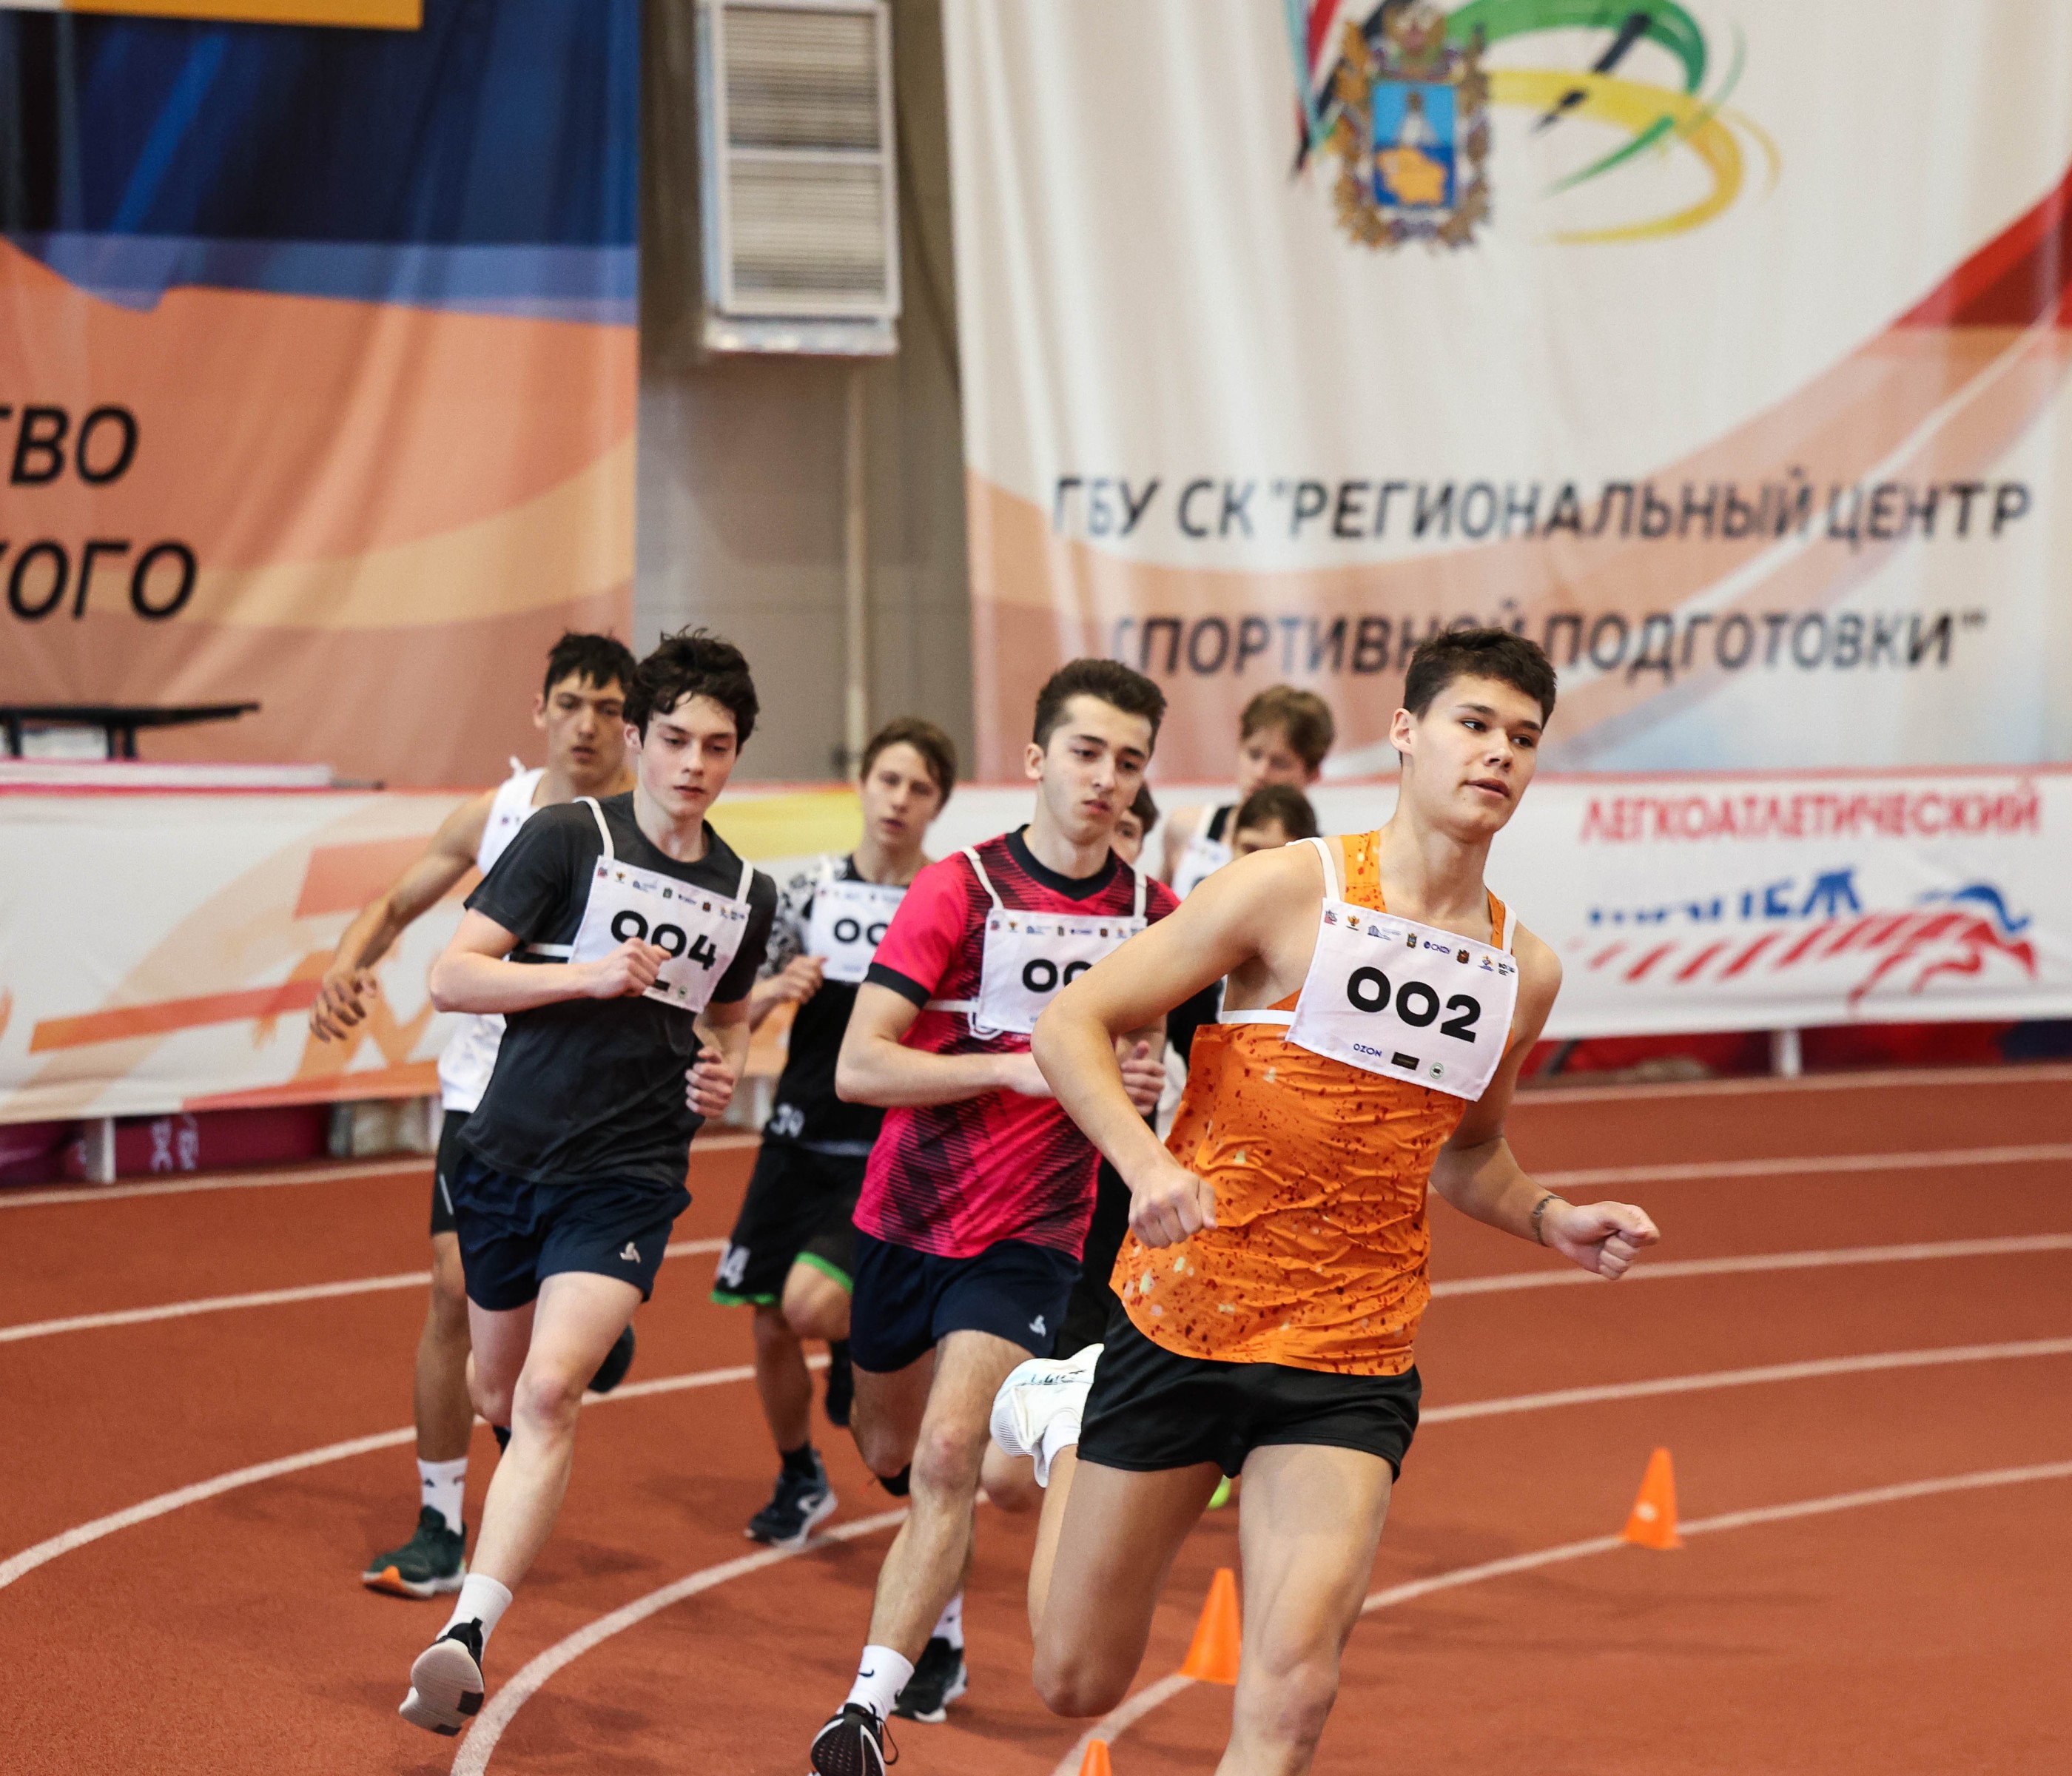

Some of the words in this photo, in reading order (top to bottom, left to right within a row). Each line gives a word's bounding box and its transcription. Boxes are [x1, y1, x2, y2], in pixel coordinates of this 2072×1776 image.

[0, 406, 139, 485] ВО
[1054, 477, 1160, 534] ГБУ
[1178, 479, 1256, 538] СК
[1828, 480, 2033, 553] ЦЕНТР
[0, 539, 198, 622] ОГО
[1112, 599, 1524, 676] СПОРТИВН
[611, 910, 716, 971] 004
[1347, 966, 1481, 1043] 002
[1353, 1043, 1382, 1057] OZON
